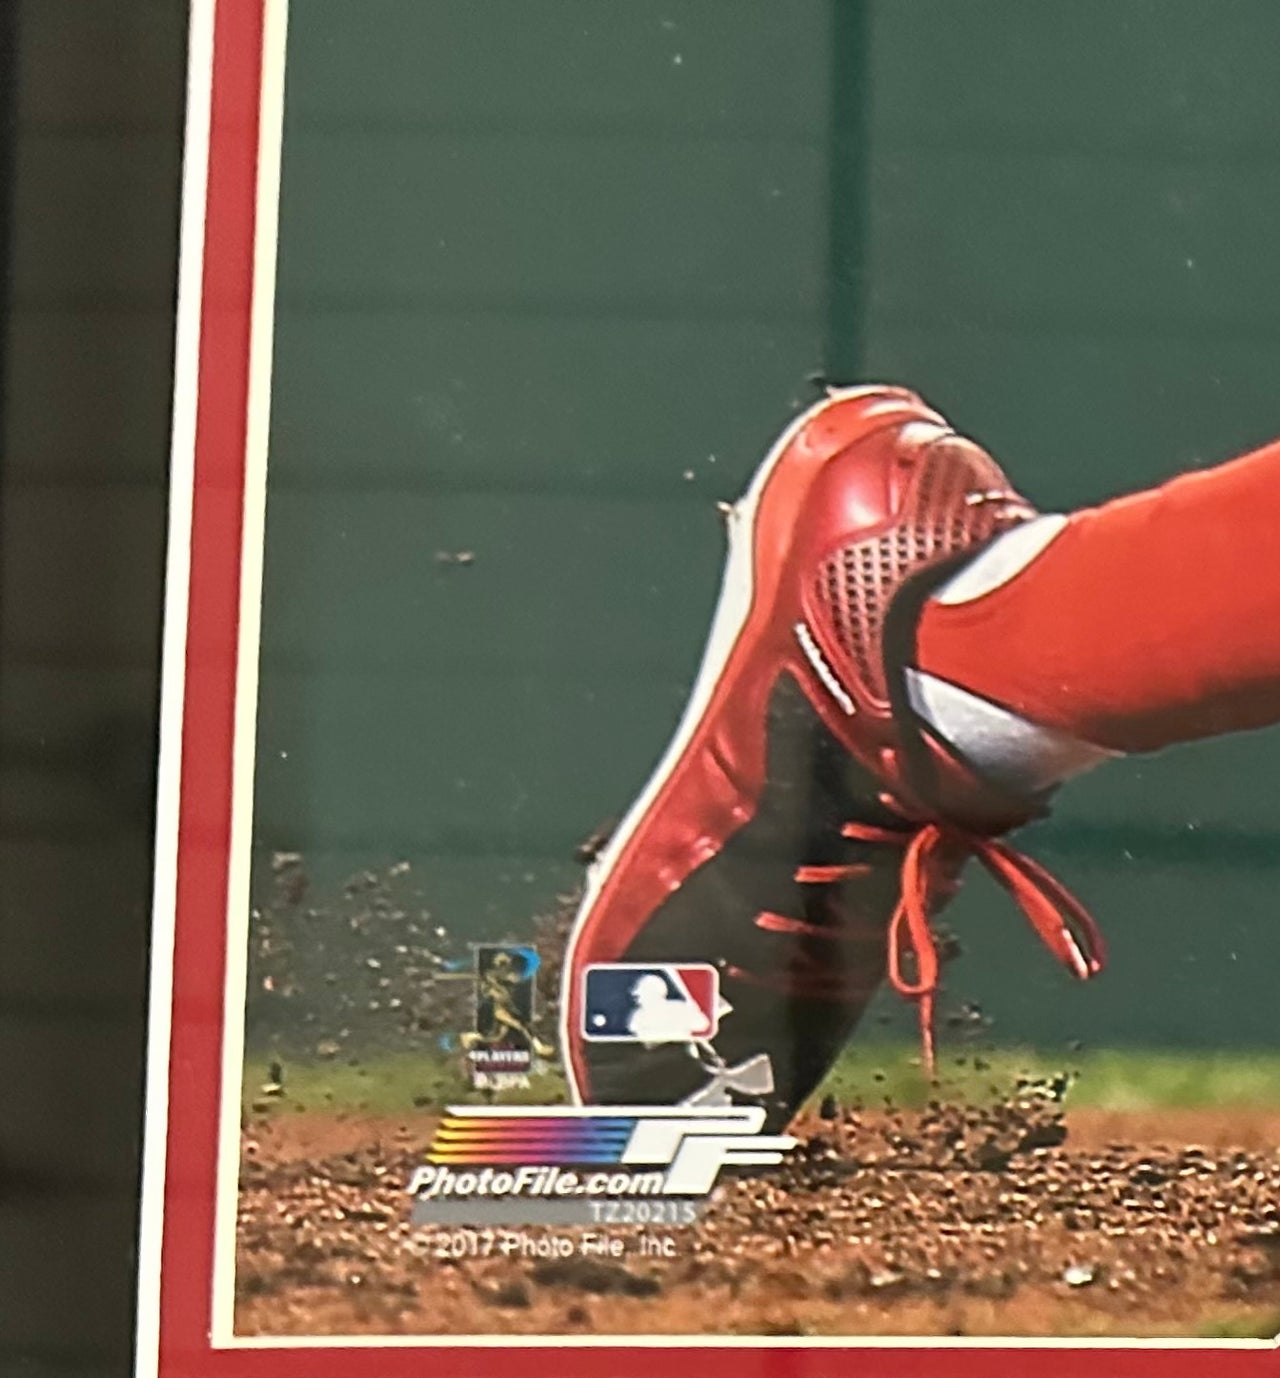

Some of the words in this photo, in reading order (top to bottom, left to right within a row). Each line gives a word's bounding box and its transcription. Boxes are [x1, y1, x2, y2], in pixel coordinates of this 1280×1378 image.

[407, 1165, 665, 1201] PhotoFile.com
[589, 1201, 697, 1223] TZ20215
[500, 1232, 575, 1259] Photo
